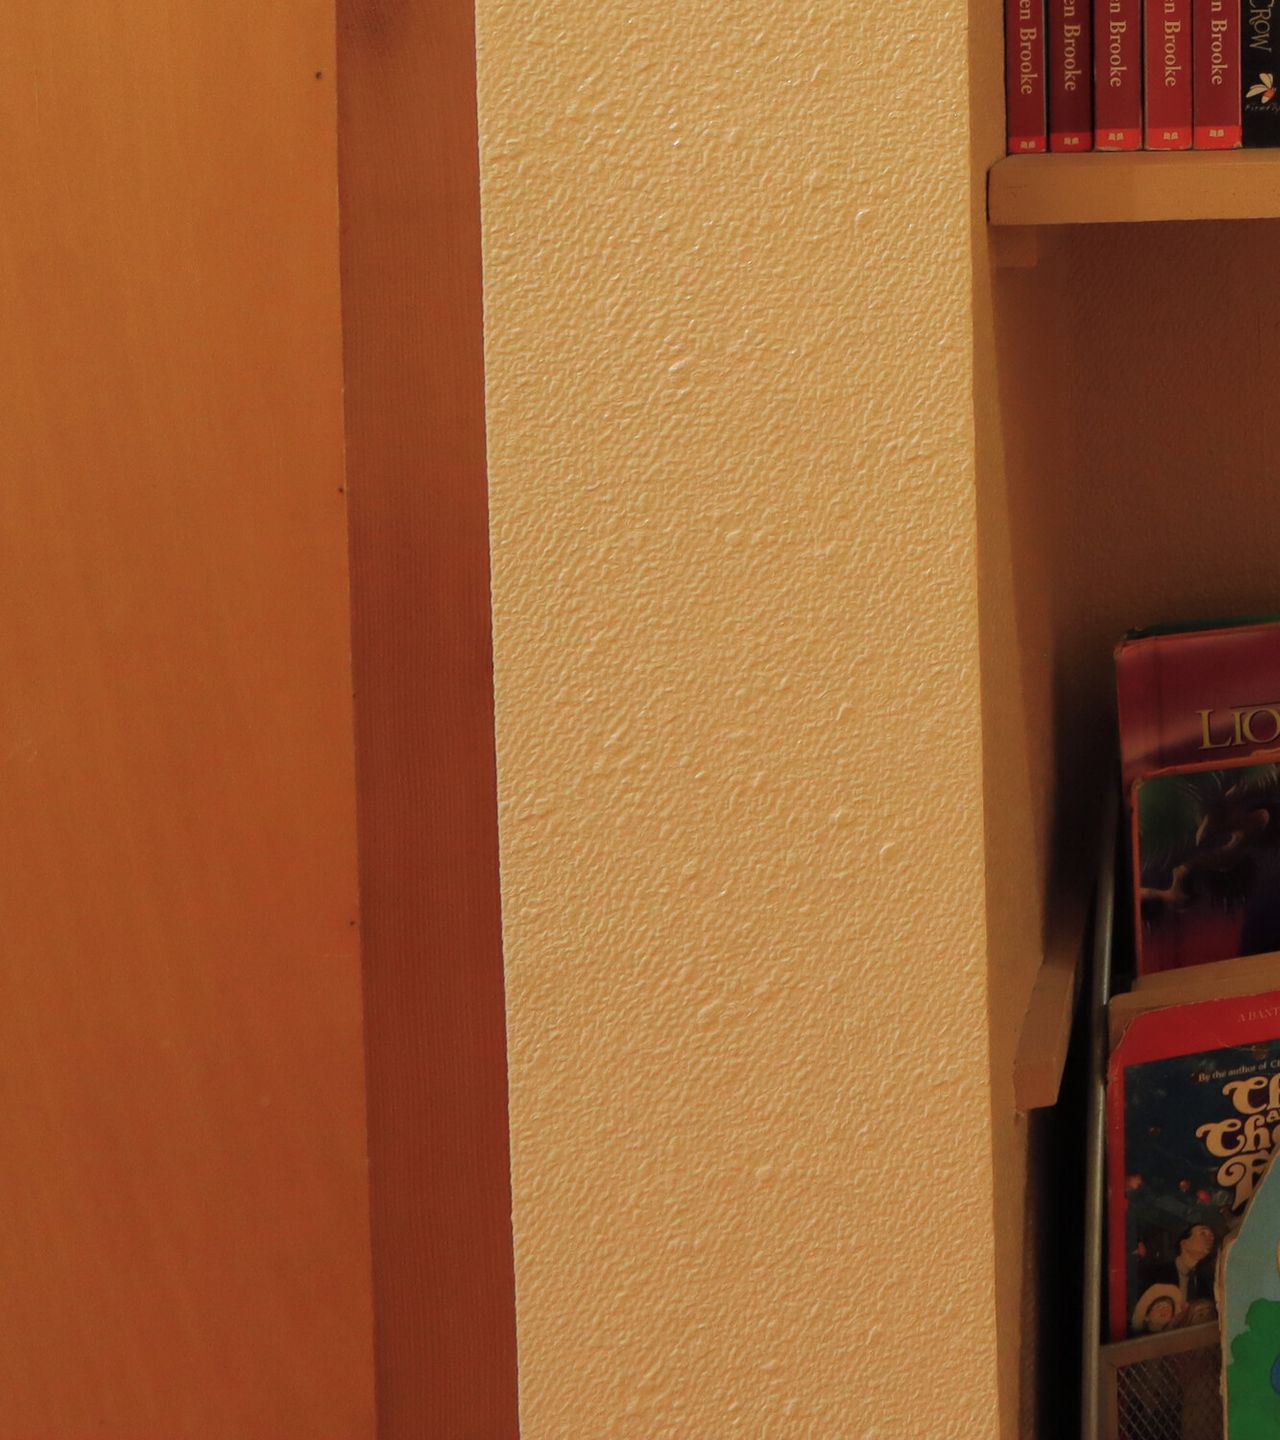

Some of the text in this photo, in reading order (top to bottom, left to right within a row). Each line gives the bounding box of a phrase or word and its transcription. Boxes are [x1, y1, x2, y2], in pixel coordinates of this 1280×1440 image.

[1019, 27, 1038, 95] Brooke
[1064, 23, 1082, 92] Brooke
[1211, 19, 1229, 86] Brooke
